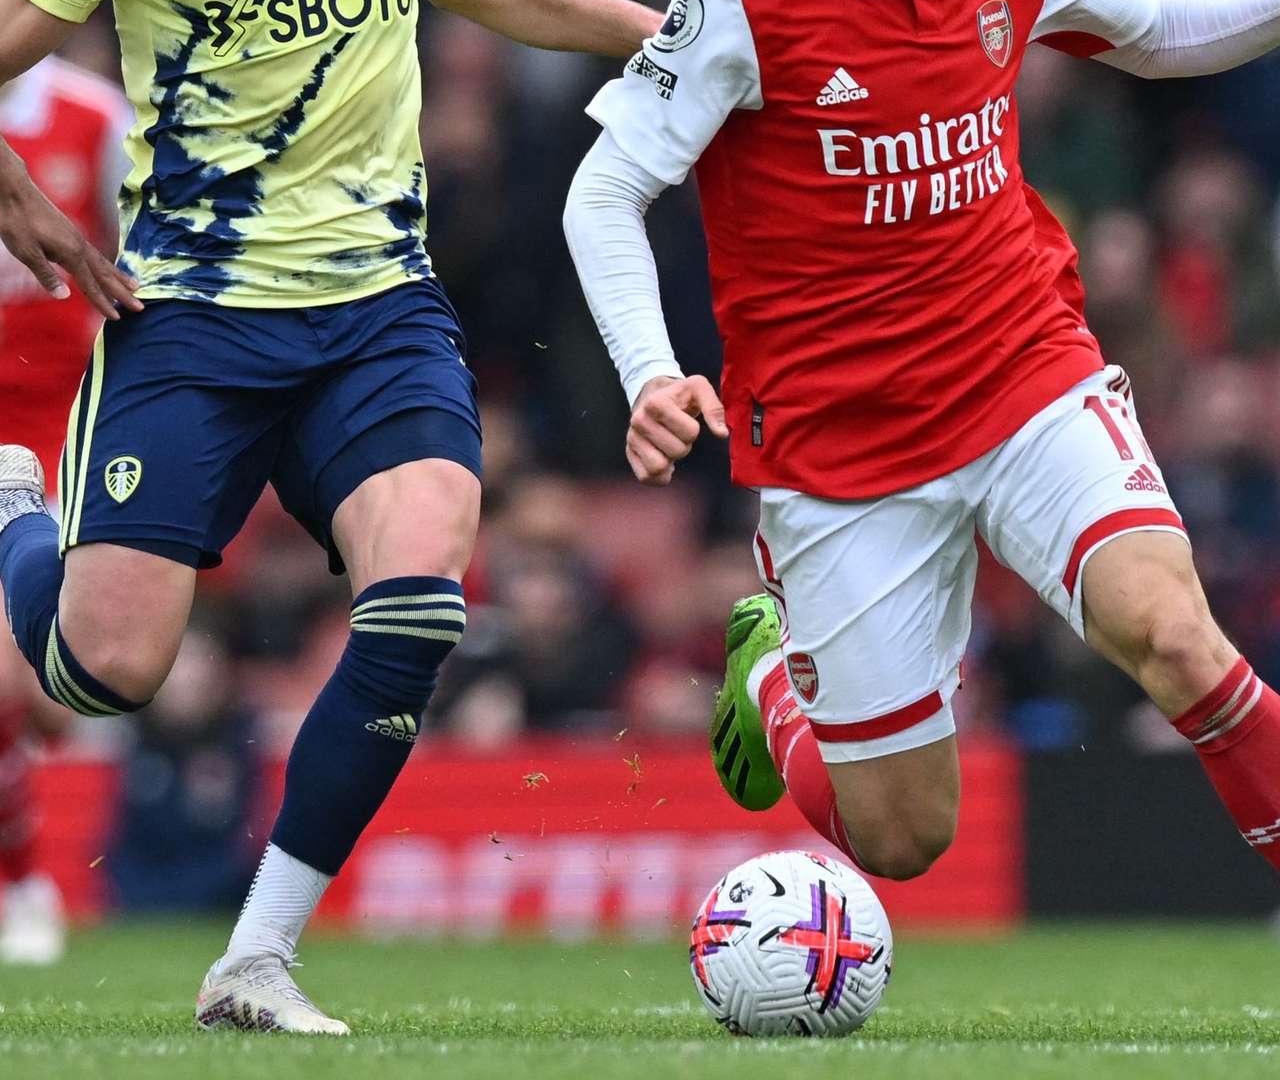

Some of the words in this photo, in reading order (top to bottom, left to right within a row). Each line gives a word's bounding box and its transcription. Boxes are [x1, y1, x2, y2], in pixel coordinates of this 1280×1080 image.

[815, 86, 869, 106] adidas
[863, 178, 918, 225] FLY
[929, 144, 1009, 216] BETTER
